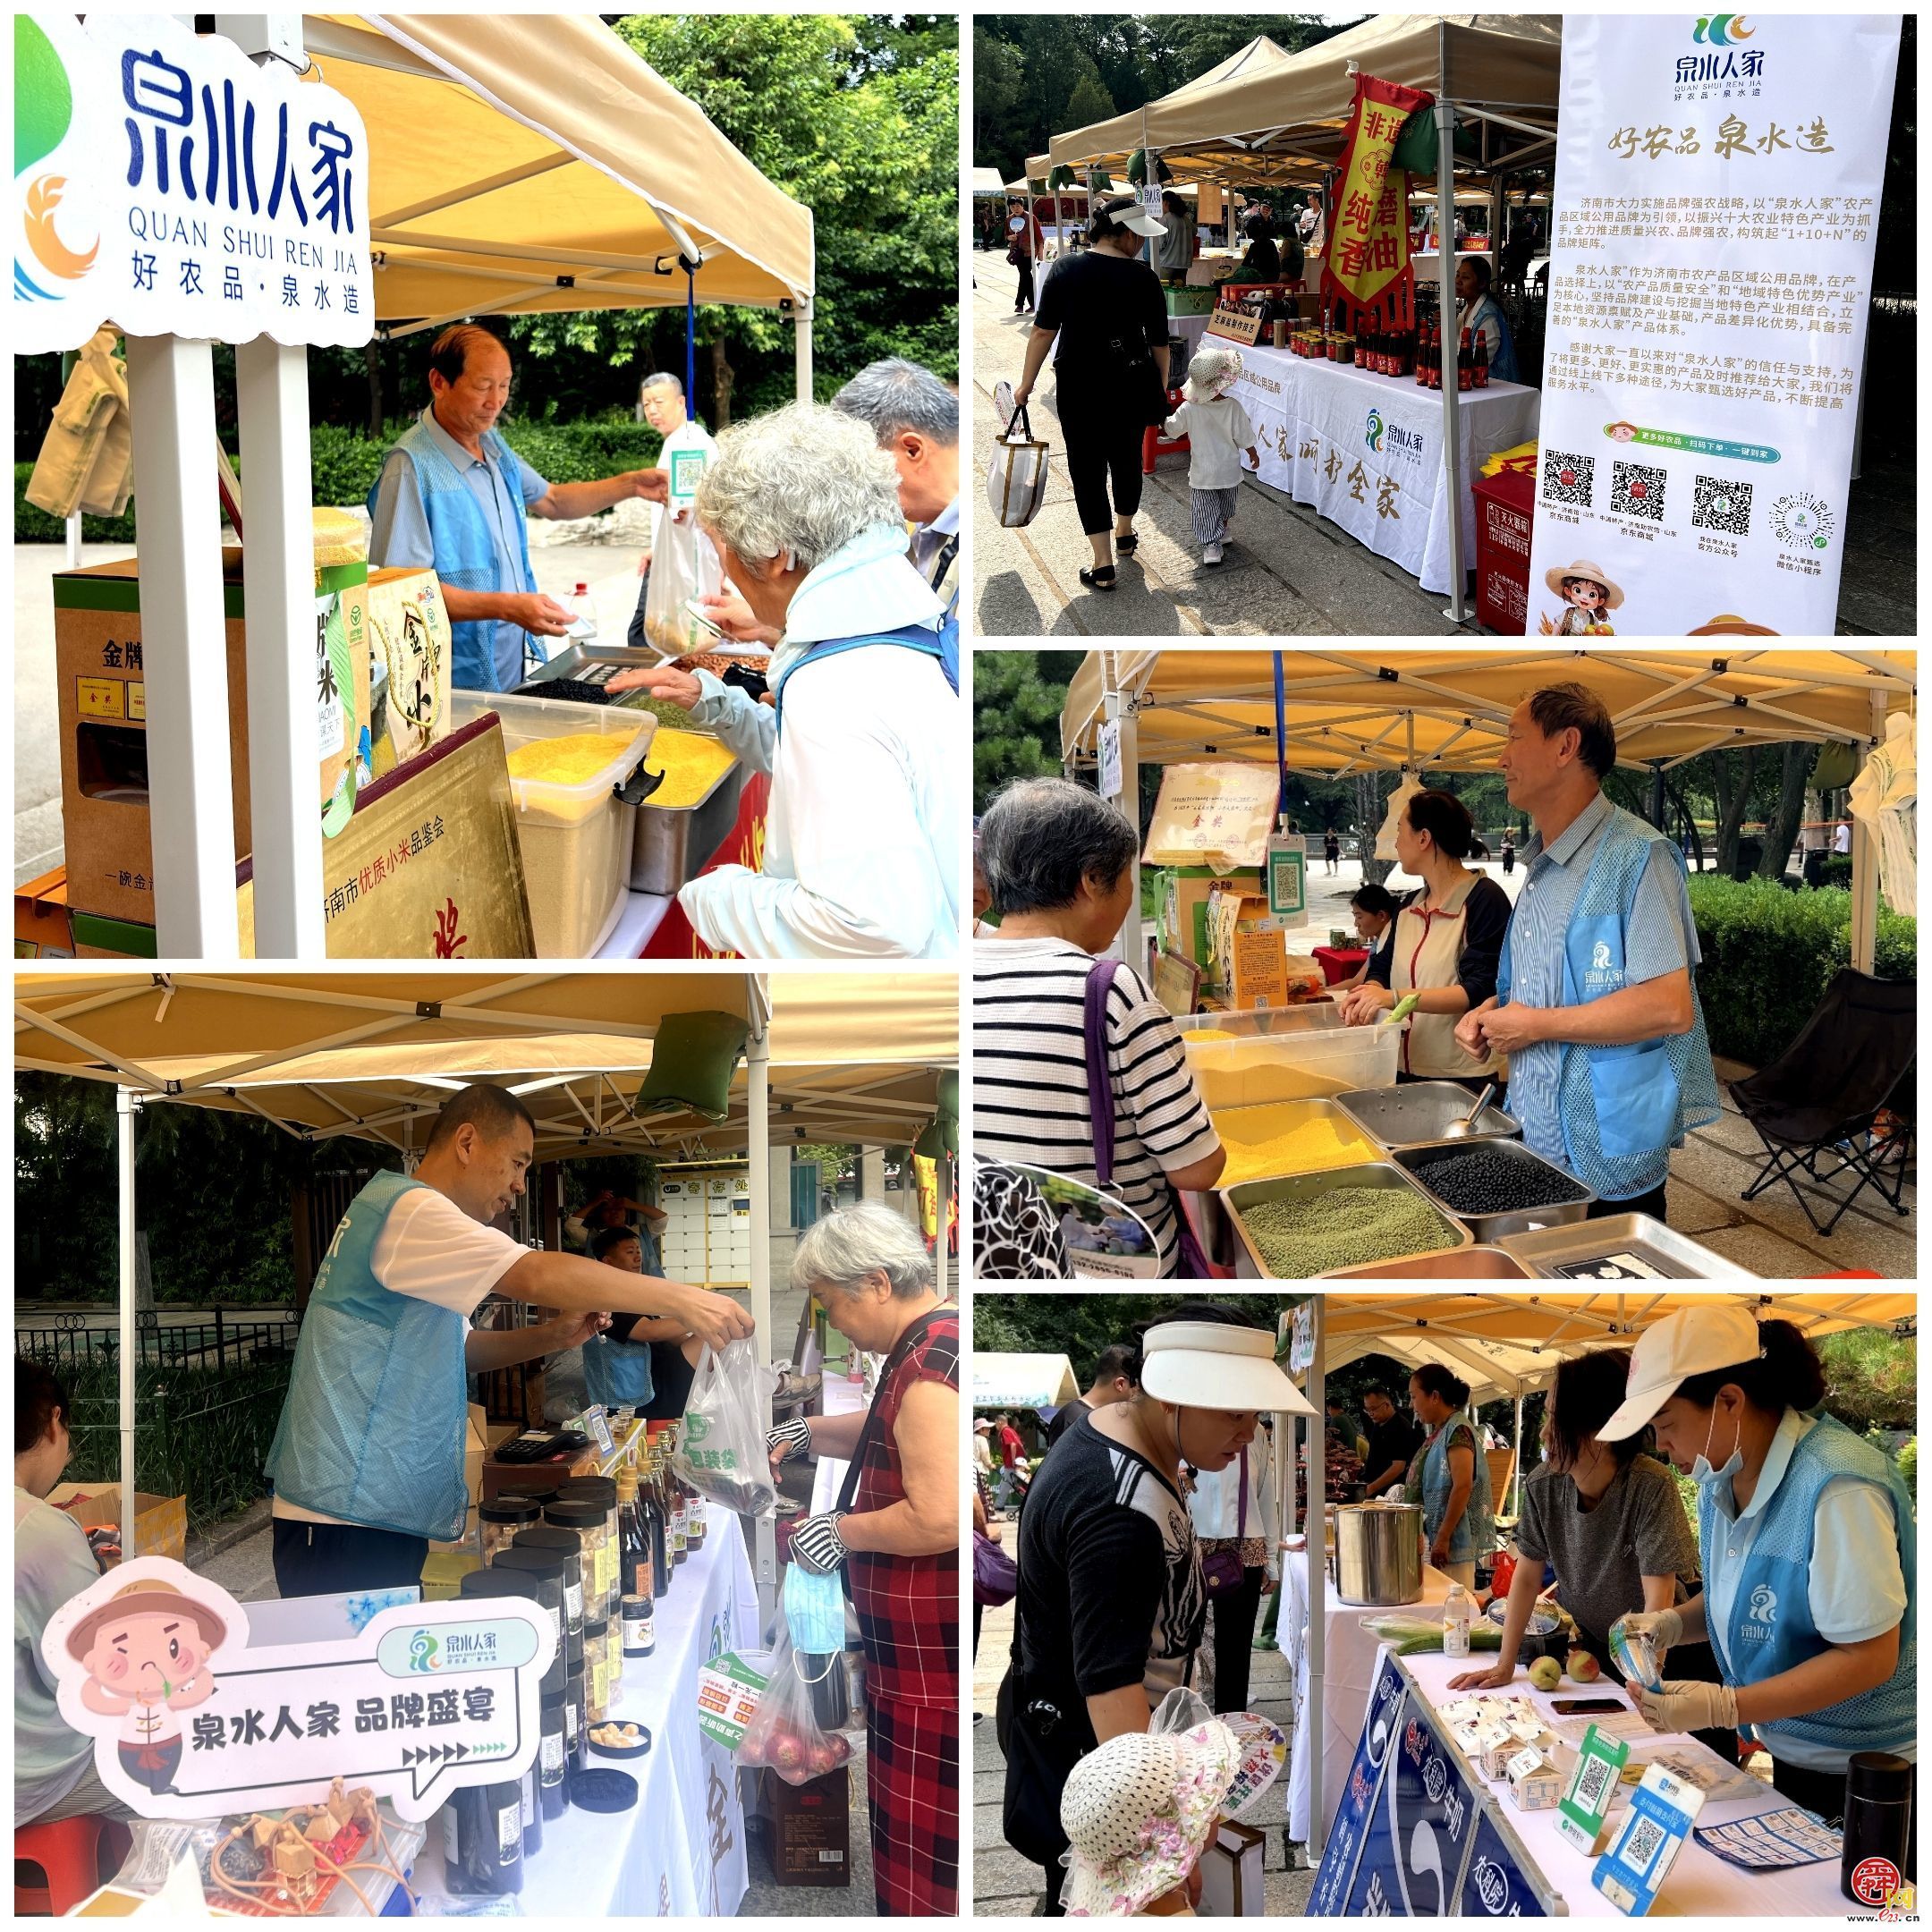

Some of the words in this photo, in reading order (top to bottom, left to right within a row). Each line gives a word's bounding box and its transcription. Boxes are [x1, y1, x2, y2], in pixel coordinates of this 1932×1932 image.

[1675, 50, 1765, 84] 泉水人家
[1674, 85, 1698, 93] QUAN
[1702, 82, 1723, 90] SHUI
[1748, 80, 1762, 88] JIA
[122, 48, 354, 235] 泉水人家
[1607, 124, 1701, 160] 好农品
[1714, 113, 1835, 160] 泉水造
[129, 207, 208, 248] QUAN
[223, 226, 274, 260] SHUI
[285, 239, 323, 268] REN
[334, 250, 358, 275] JIA
[1388, 425, 1423, 452] 泉水人家
[1698, 543, 1739, 558] 官方公众号
[1776, 560, 1822, 576] 微信小程序
[1585, 970, 1623, 984] 泉水人家
[447, 1632, 496, 1653] 泉水人家
[191, 1700, 341, 1751] 泉水人家
[357, 1687, 495, 1733] 品牌盛宴
